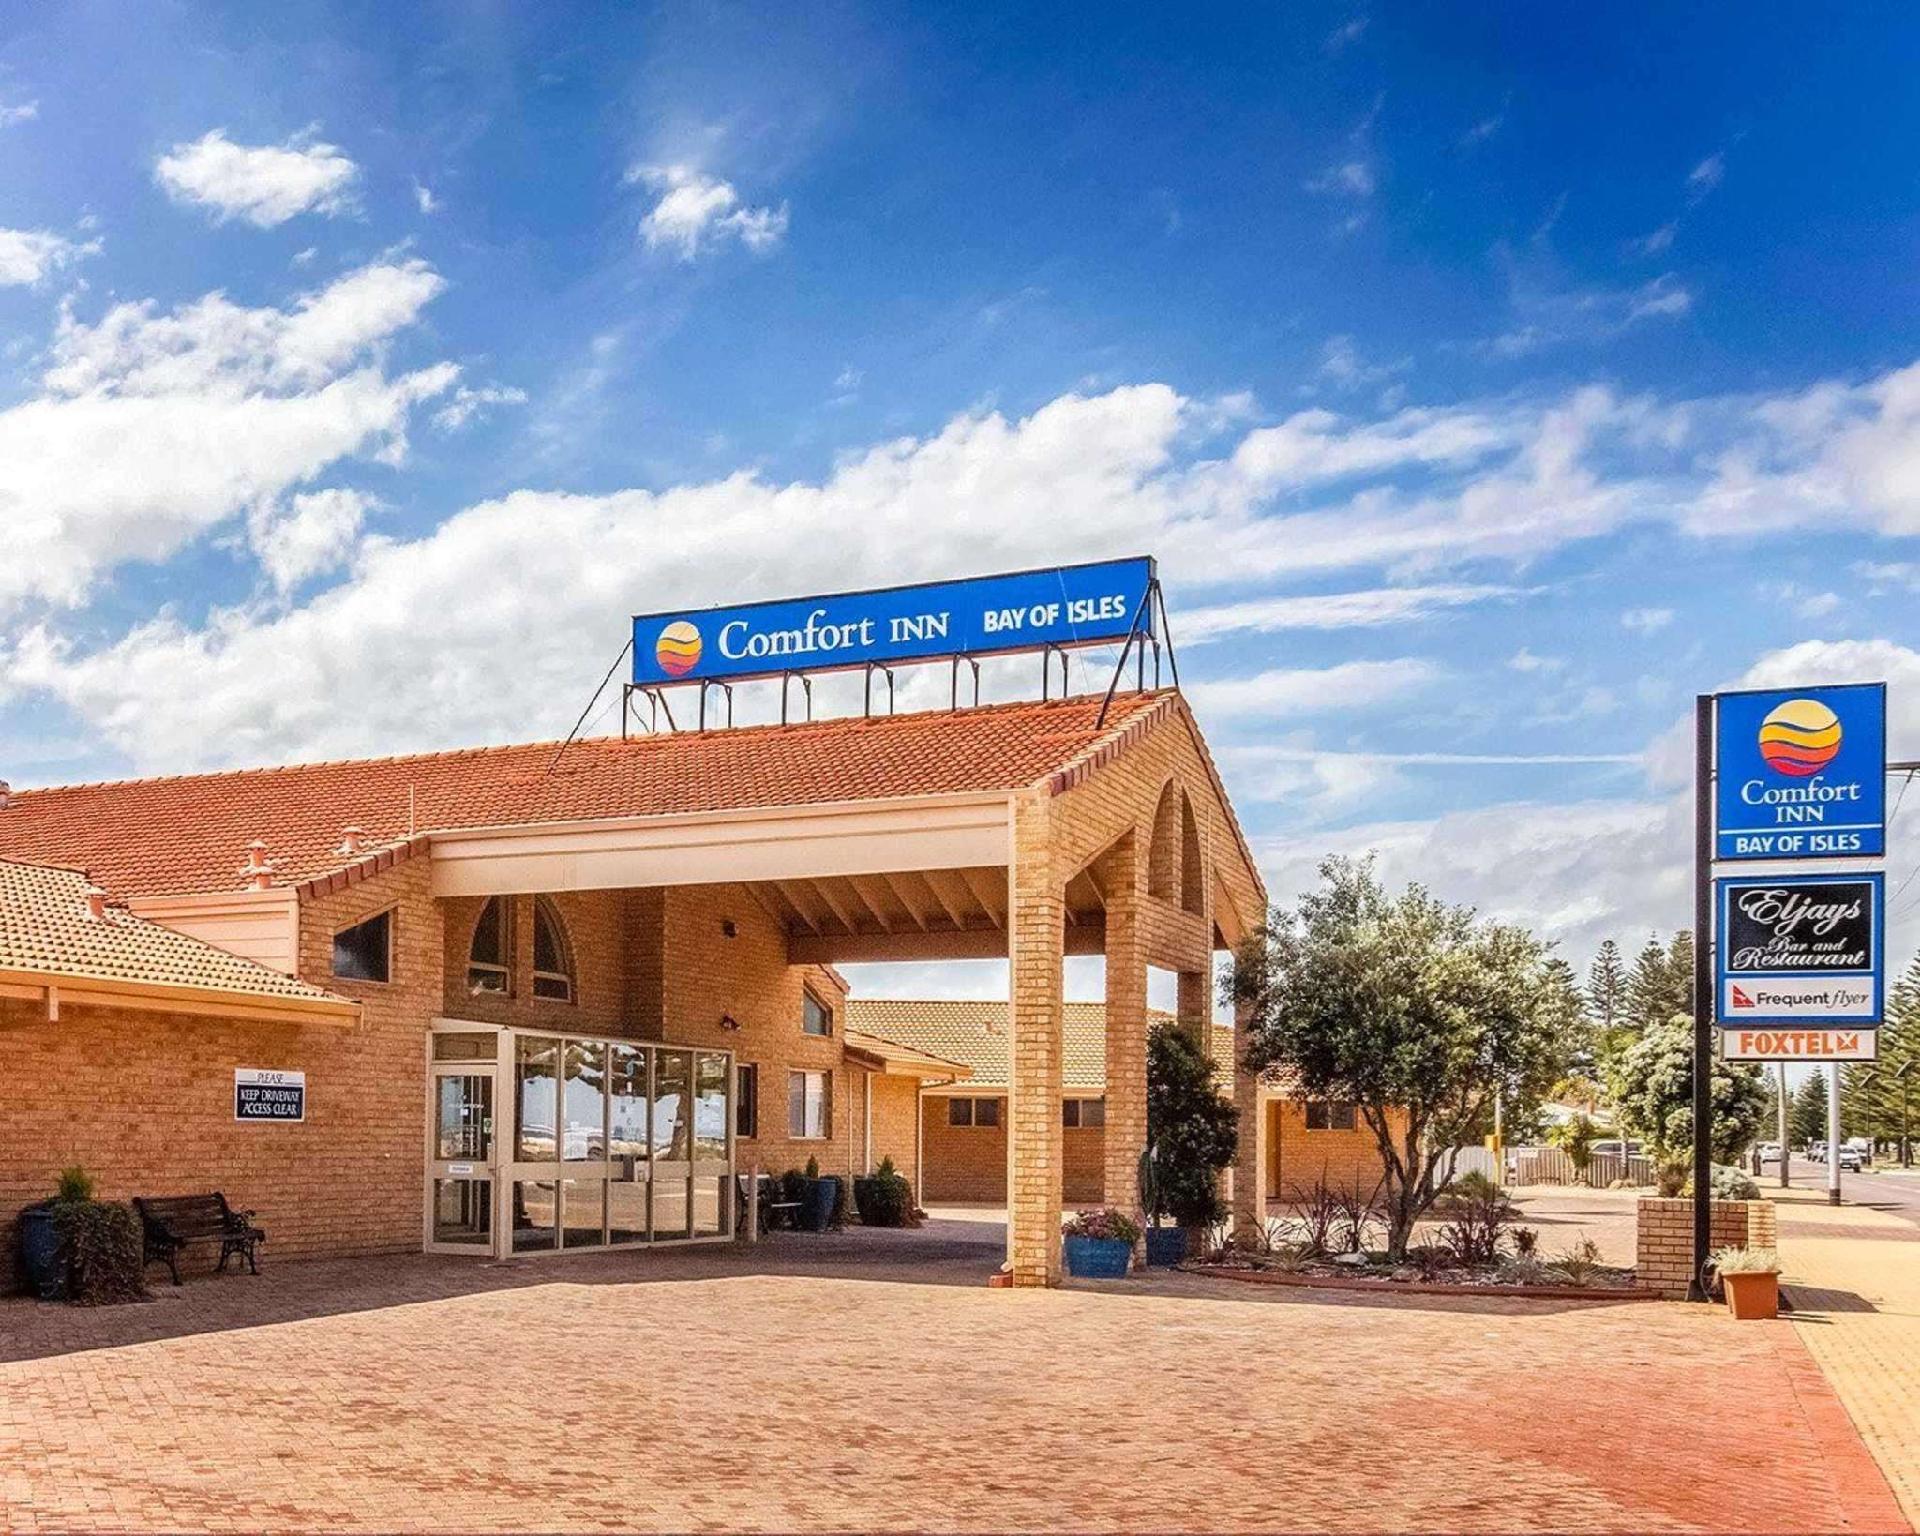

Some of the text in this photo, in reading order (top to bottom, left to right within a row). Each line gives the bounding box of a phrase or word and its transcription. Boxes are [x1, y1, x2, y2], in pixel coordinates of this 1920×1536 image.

[718, 594, 1126, 660] Comfort INN BAY OF ISLES
[1741, 776, 1861, 805] Comfort
[1776, 805, 1825, 823] INN
[1736, 833, 1861, 853] BAY OF ISLES
[1738, 889, 1861, 936] Eljays
[1768, 936, 1847, 953] Bar and
[1733, 947, 1865, 969] Restaurant
[1757, 990, 1869, 1009] Frequent flyer
[1740, 1032, 1834, 1054] FOXTEL
[241, 1089, 300, 1103] KEEP DRIVEWAY
[242, 1102, 297, 1115] ACCESS CLEAR
